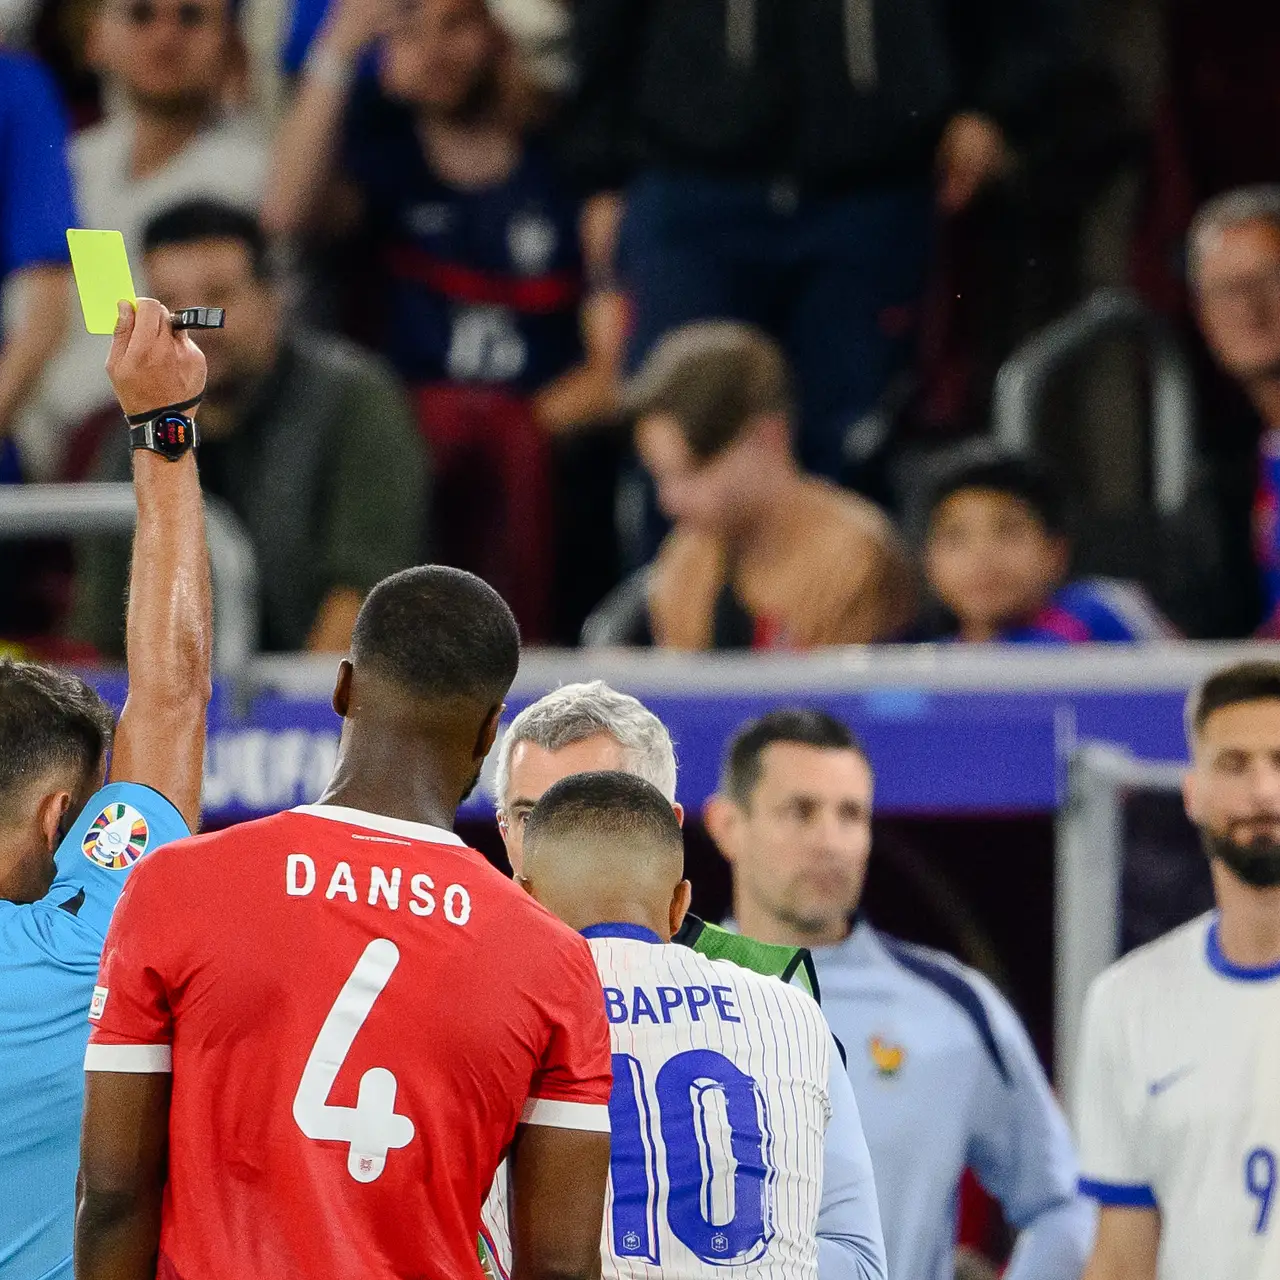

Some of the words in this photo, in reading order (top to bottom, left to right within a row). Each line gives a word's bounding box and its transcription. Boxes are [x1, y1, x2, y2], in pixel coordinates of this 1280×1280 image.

[286, 853, 472, 927] DANSO
[293, 937, 416, 1184] 4
[609, 1048, 777, 1267] 10
[1245, 1147, 1280, 1234] 9
